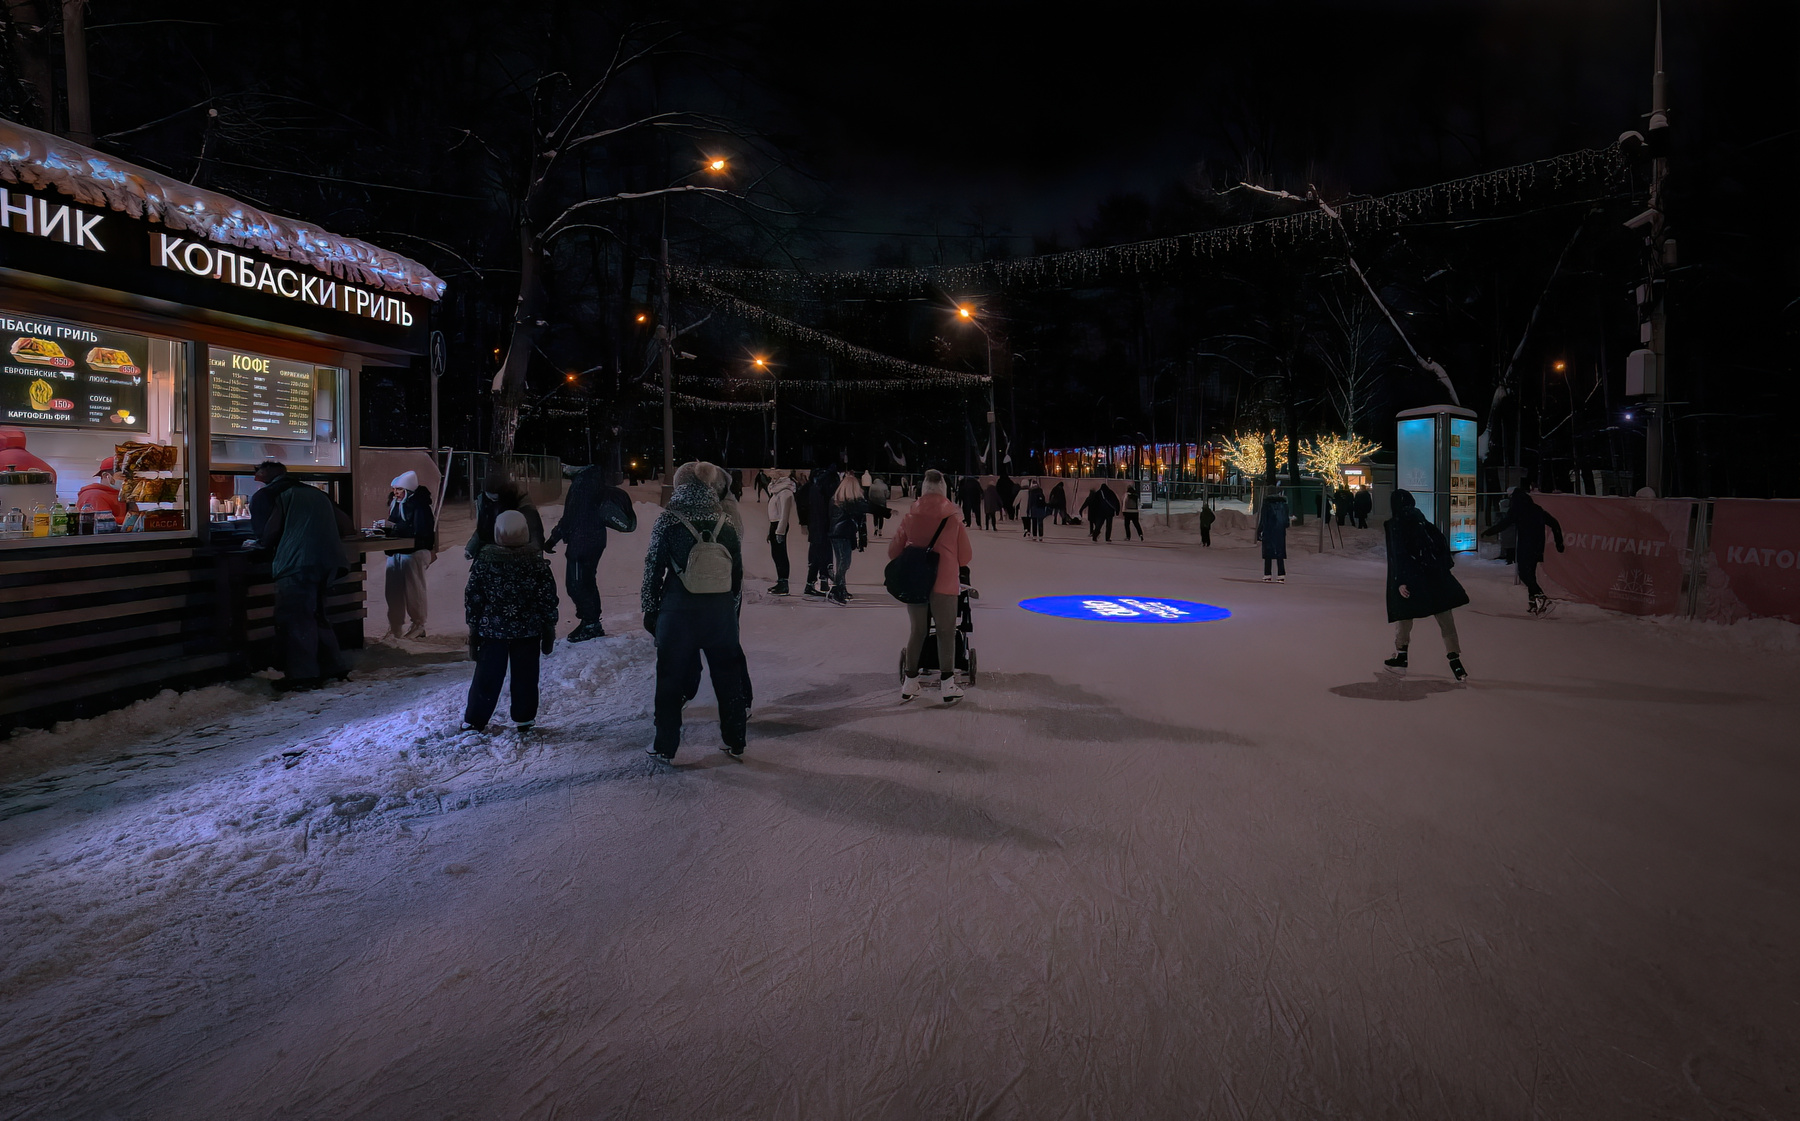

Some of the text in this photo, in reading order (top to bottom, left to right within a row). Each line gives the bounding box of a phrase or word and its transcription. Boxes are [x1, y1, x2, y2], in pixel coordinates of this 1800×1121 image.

[0, 187, 106, 252] НИК
[160, 233, 414, 327] КОЛБАСКИ ГРИЛЬ
[56, 326, 98, 343] ГРИЛЬ
[232, 354, 270, 374] КОФЕ
[4, 366, 57, 379] ЕВРОПЕЙСКИЕ
[89, 375, 108, 384] ЛЮКС
[89, 395, 112, 403] СОУСЫ
[8, 410, 70, 421] КАРТОФЕЛЬ ФРИ
[150, 520, 178, 529] КАССА
[1591, 535, 1666, 557] ГИГАНТ
